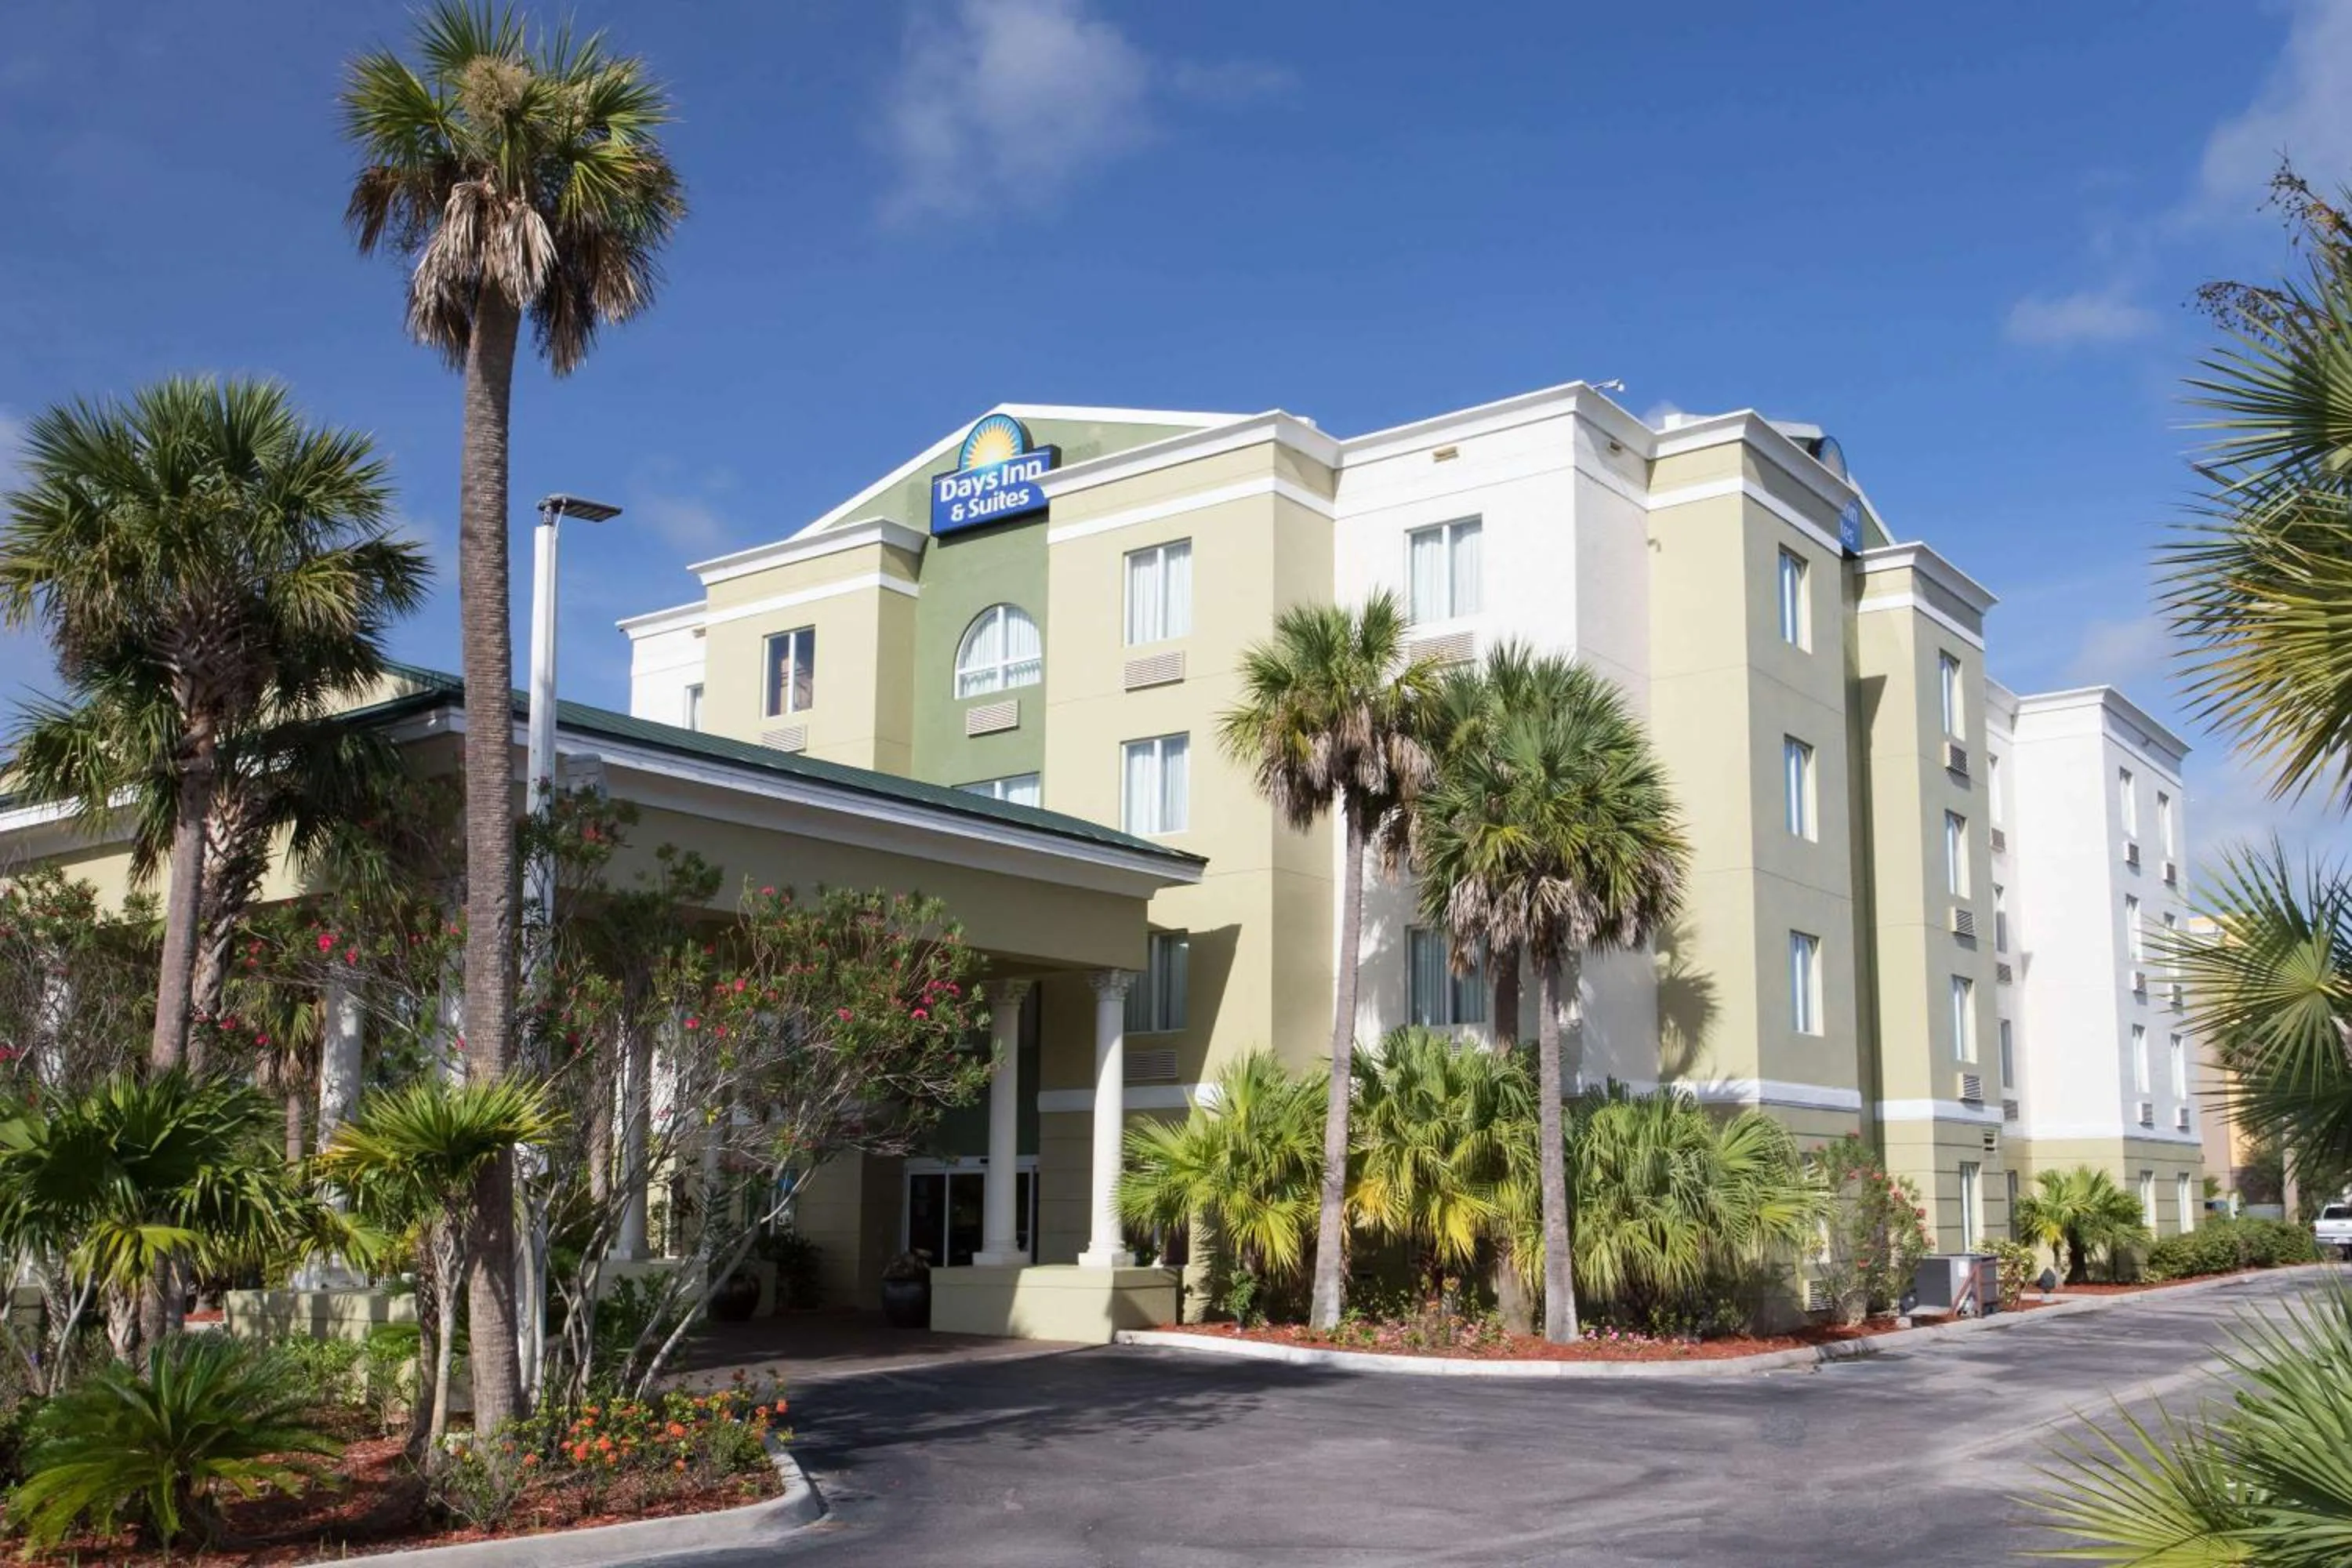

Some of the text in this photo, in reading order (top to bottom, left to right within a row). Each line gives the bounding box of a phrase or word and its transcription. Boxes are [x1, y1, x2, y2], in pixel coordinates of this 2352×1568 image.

[940, 459, 1043, 503] Days Inn
[950, 488, 1029, 522] & Suites
